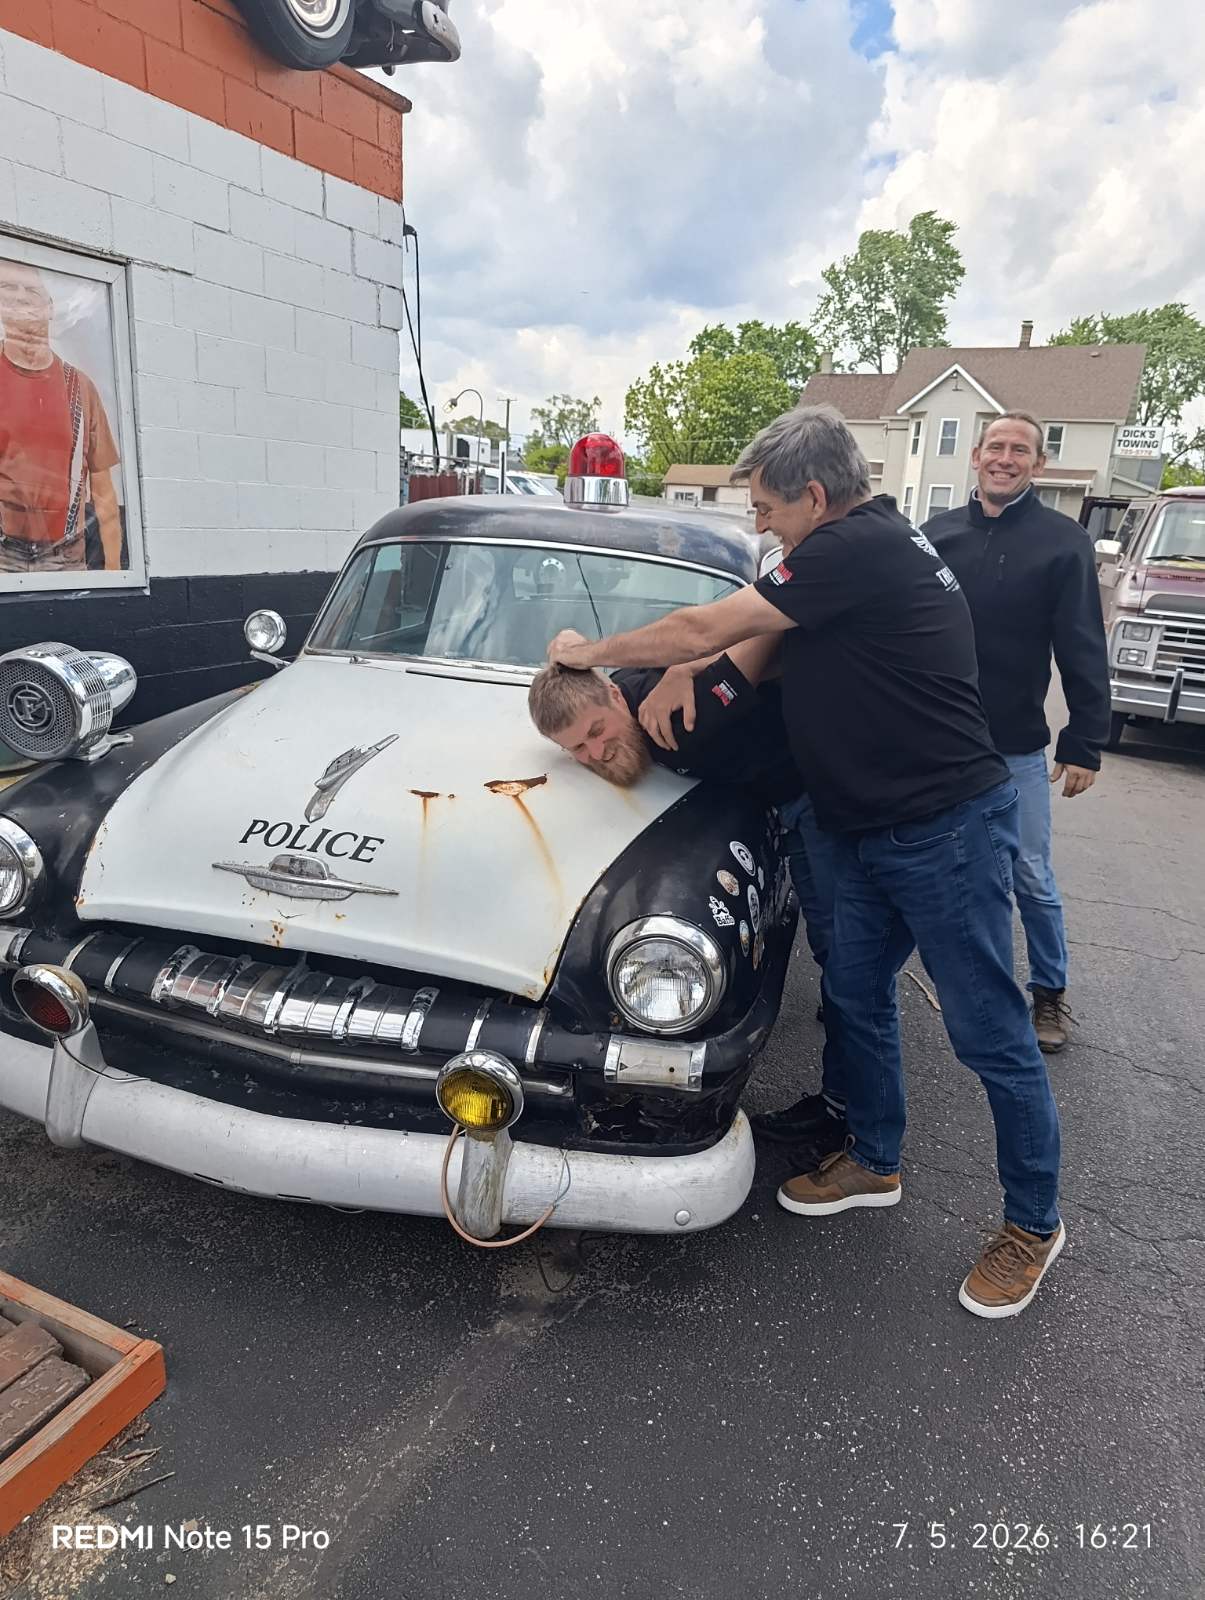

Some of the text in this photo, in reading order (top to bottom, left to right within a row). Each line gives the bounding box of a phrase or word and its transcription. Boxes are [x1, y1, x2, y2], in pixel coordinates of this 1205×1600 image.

[1122, 429, 1156, 438] DICK'S
[1117, 439, 1159, 448] TOWING
[239, 819, 385, 863] POLICE
